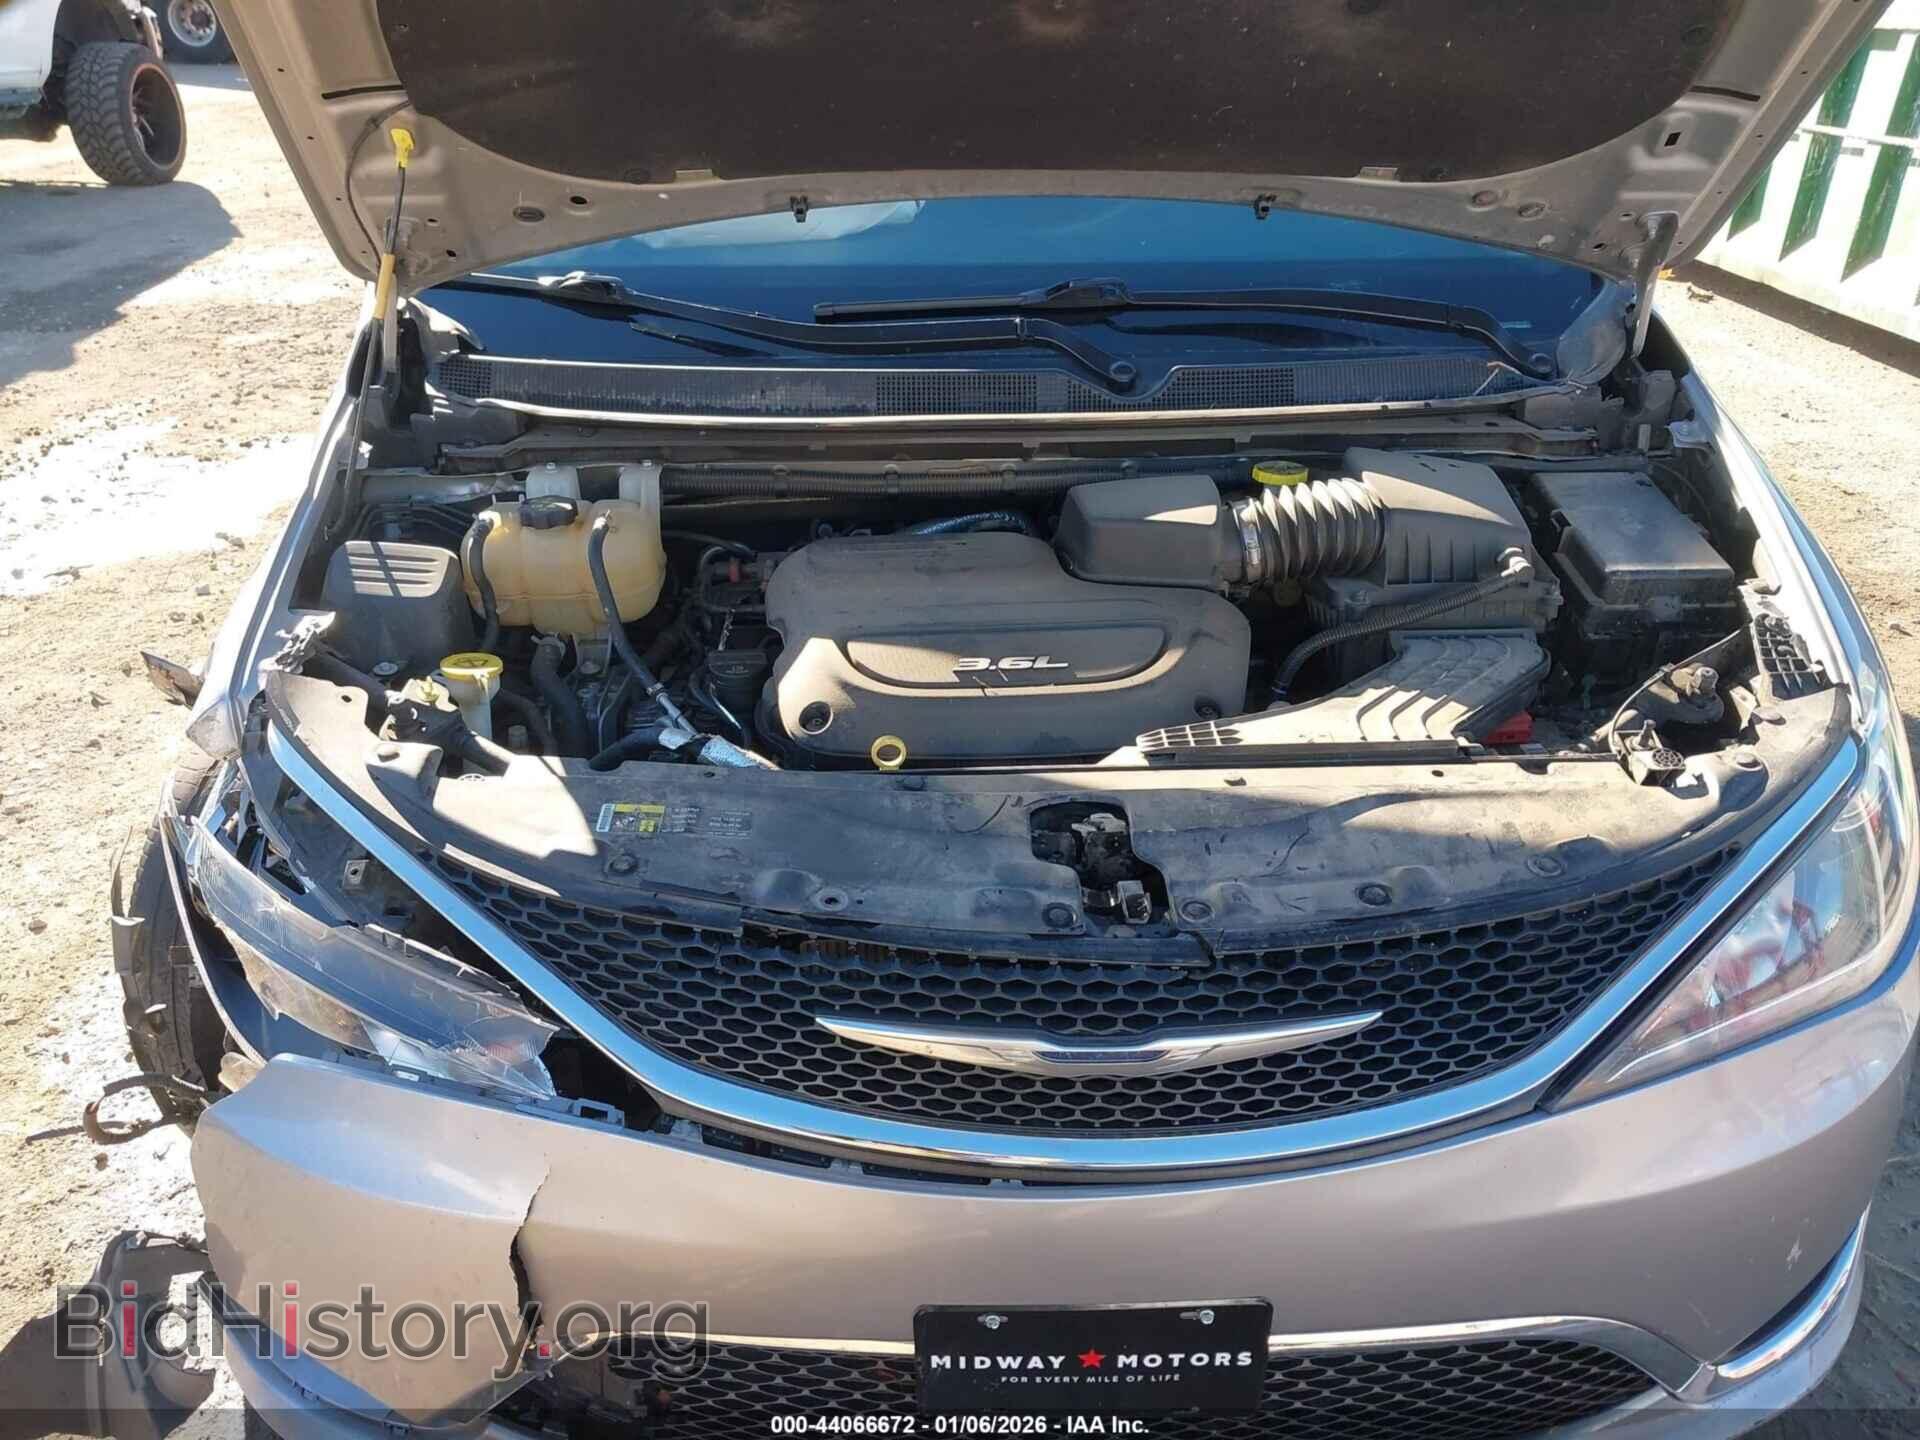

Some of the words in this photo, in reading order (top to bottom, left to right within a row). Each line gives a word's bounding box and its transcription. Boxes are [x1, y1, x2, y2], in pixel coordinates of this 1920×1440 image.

[952, 655, 1069, 671] 3.6L
[931, 1355, 1066, 1370] MIDWAY
[1117, 1351, 1253, 1368] MOTORS
[1001, 1376, 1028, 1384] FOR
[1035, 1376, 1080, 1384] EVERY
[1086, 1375, 1120, 1384] MILE
[1126, 1375, 1145, 1383] OF
[1151, 1373, 1181, 1382] LIFE
